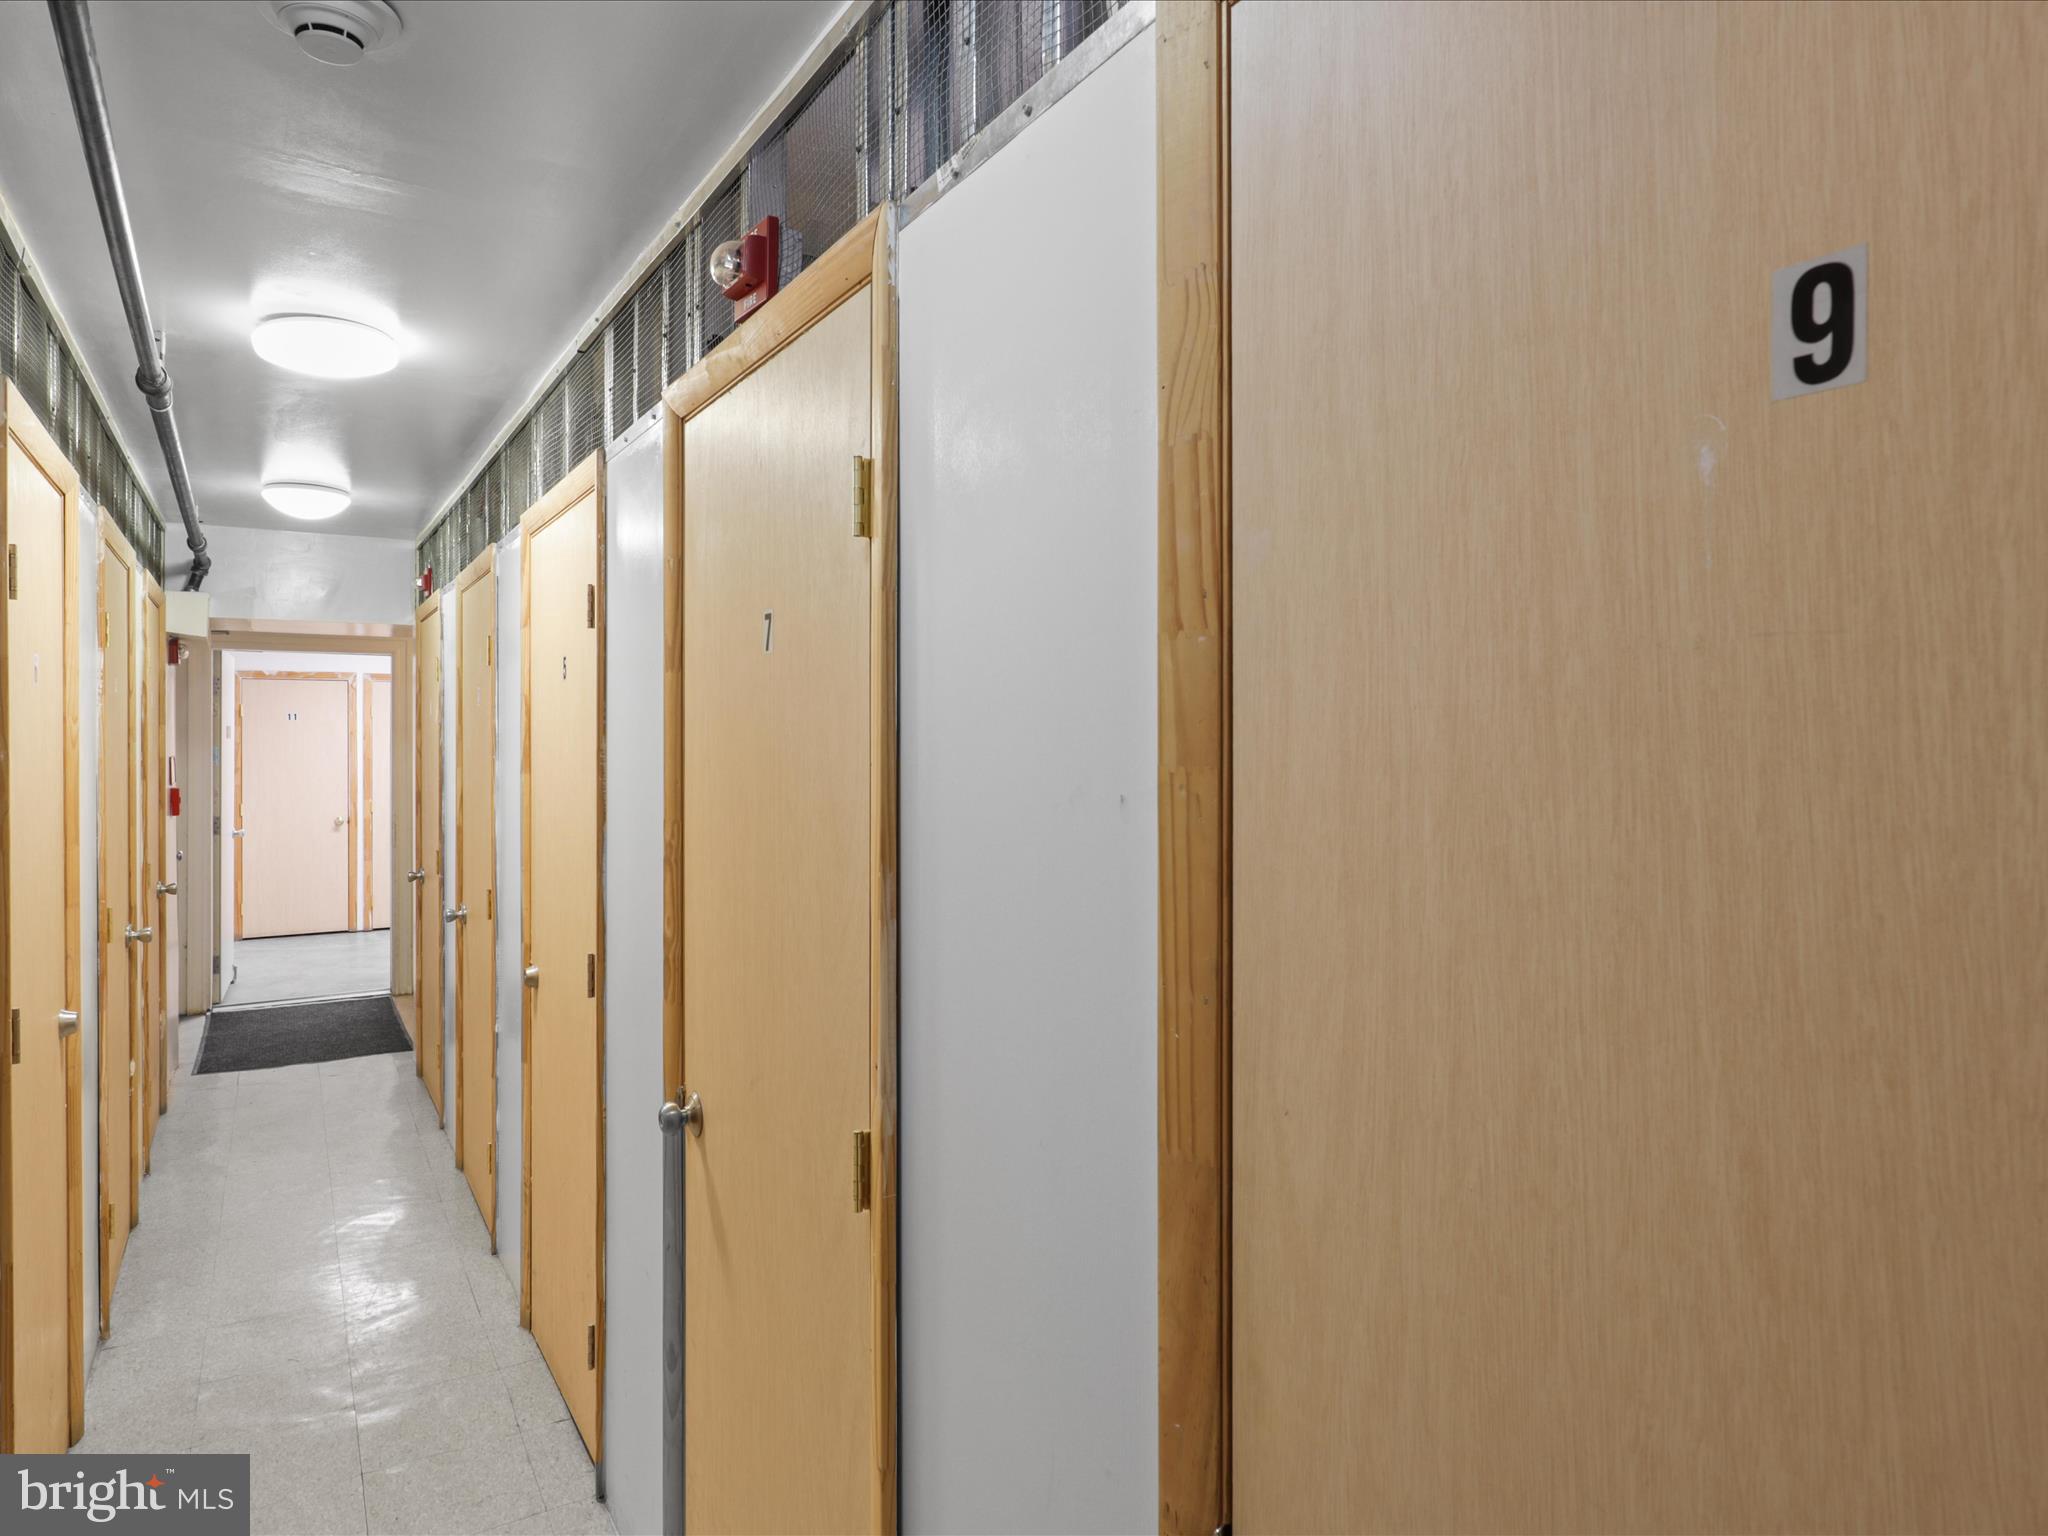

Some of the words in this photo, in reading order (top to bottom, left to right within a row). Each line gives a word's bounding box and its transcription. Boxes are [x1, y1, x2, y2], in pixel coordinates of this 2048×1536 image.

[1791, 261, 1855, 385] 9
[764, 612, 772, 652] 7
[287, 713, 297, 721] 11
